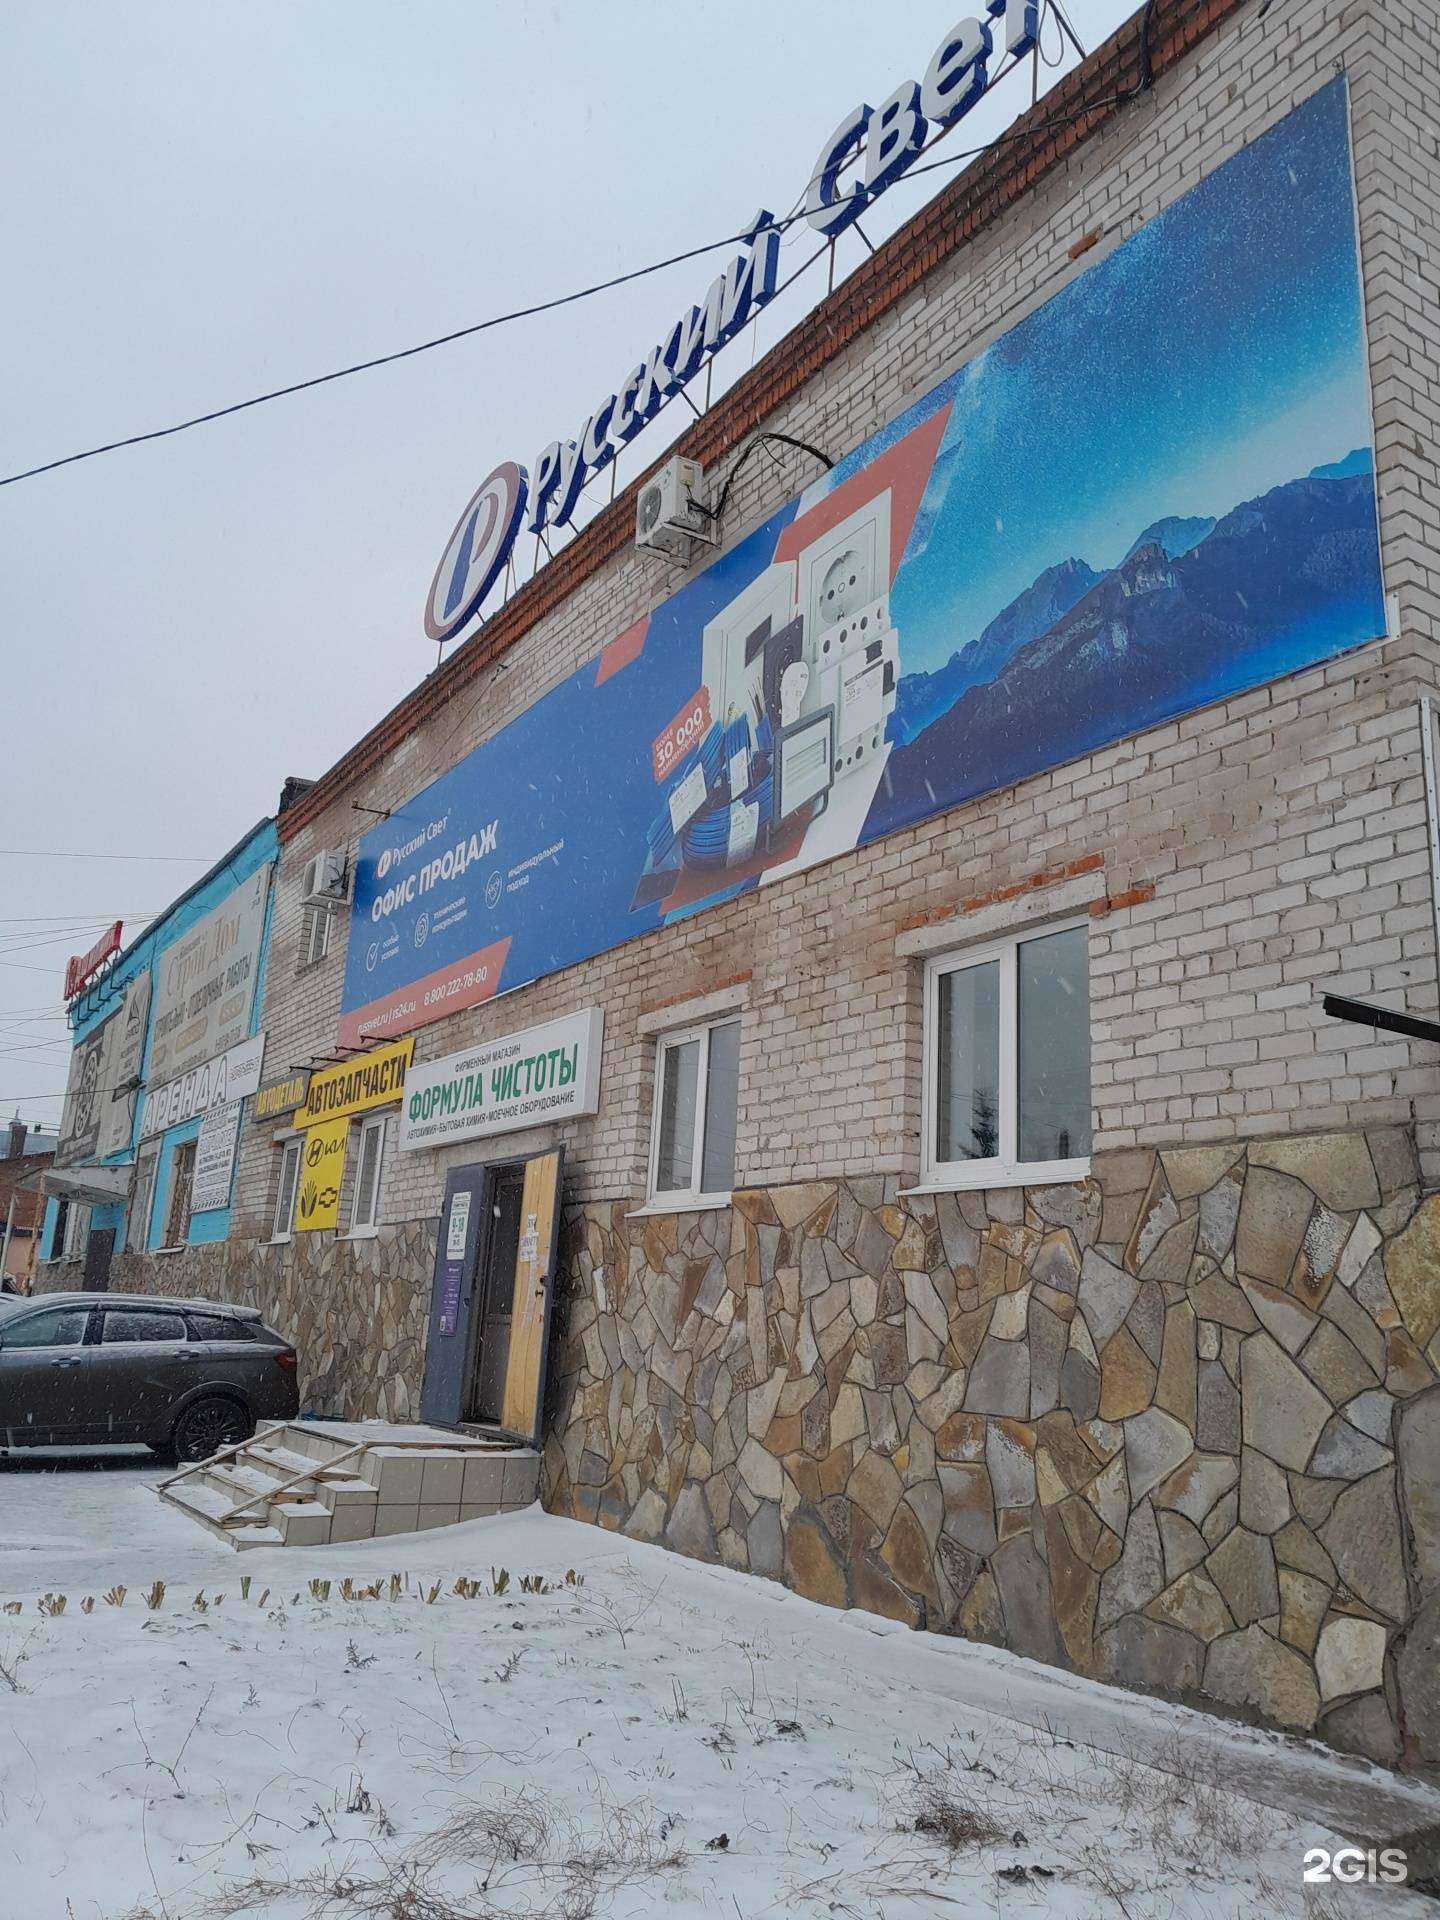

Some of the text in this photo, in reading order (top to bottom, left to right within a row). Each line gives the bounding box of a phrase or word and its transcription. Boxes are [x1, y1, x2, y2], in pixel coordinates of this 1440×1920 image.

[527, 208, 781, 534] Русский
[676, 707, 703, 745] 000
[371, 818, 499, 922] ОФИС ПРОДАЖ
[392, 815, 449, 866] Русский Свет
[307, 1053, 407, 1117] АВТОЗАПЧАСТИ
[409, 1042, 578, 1124] ФОРМУЛА ЧИСТОТЫ
[455, 1042, 521, 1073] ФИРМЕННЫЙ МАГАЗИН
[141, 1054, 228, 1138] АРЕНДА
[519, 1090, 575, 1115] ОБОРУДОВАНИЕ
